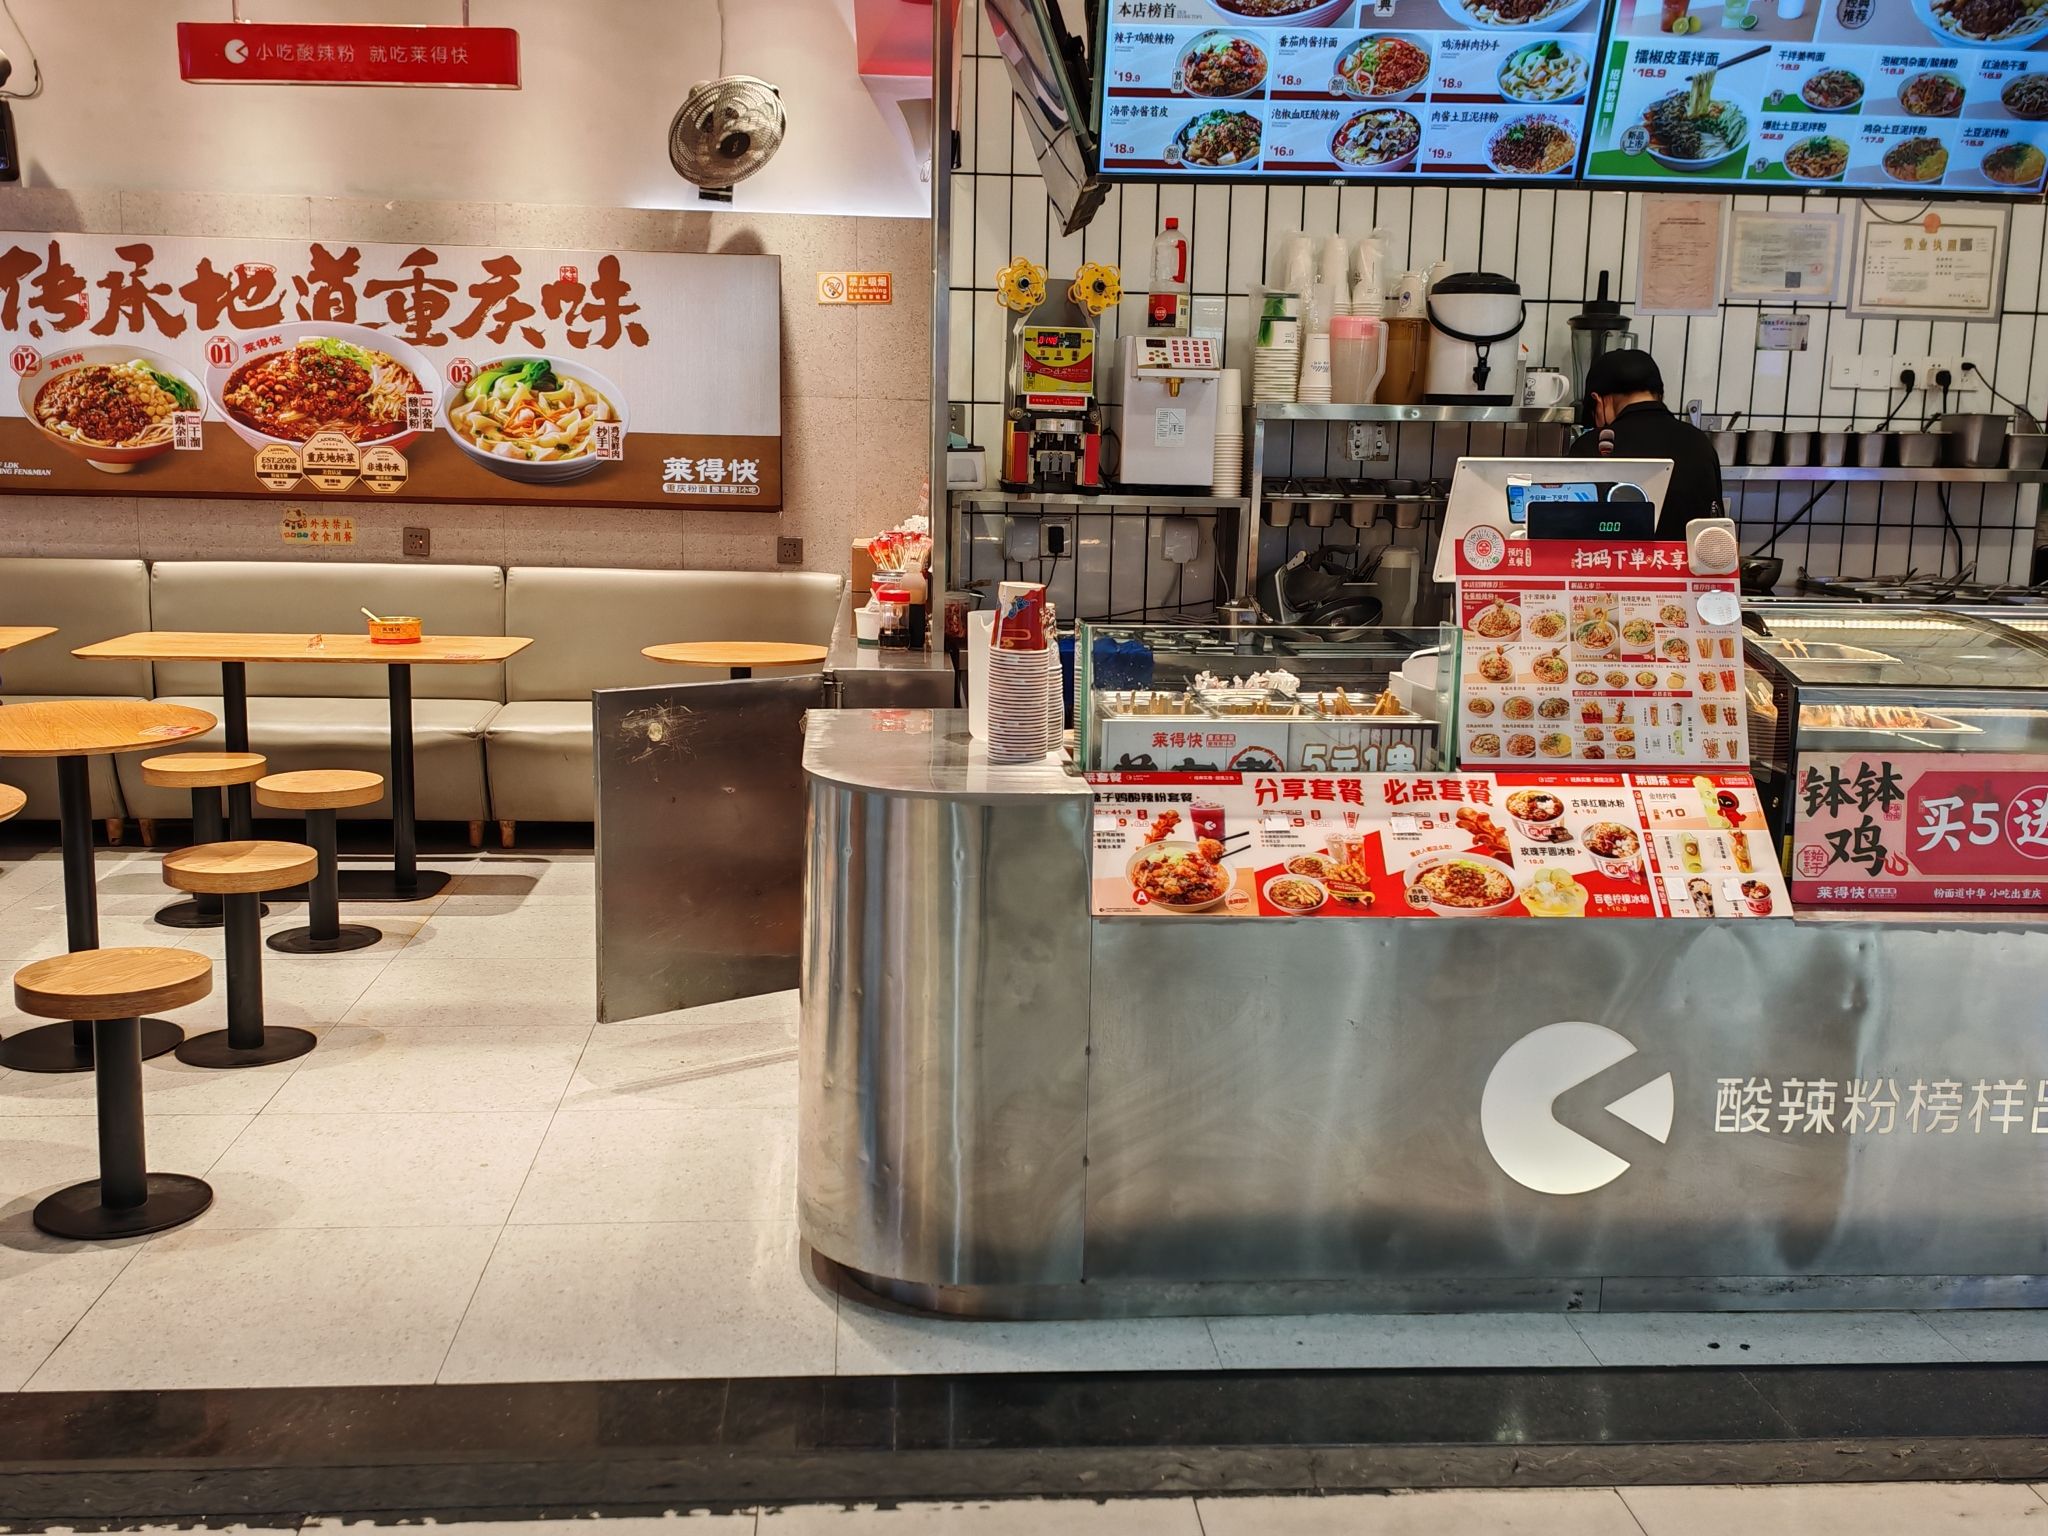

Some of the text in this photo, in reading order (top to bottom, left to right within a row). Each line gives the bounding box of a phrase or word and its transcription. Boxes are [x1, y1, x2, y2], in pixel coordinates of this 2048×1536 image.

[1118, 3, 1177, 19] 本店榜首
[1114, 32, 1175, 45] 辣子鸡酸辣粉
[1278, 35, 1338, 47] 番茄肉酱拌面
[1441, 39, 1500, 51] 鸡汤鲜肉抄手
[256, 43, 469, 65] 小吃酸辣粉 就吃莱得快
[1634, 49, 1720, 66] 擂椒皮蛋拌面
[1109, 105, 1169, 118] 海带杂酱苕皮
[1271, 108, 1340, 121] 泡椒血旺酸辣粉
[1431, 111, 1499, 123] 肉酱土豆泥拌粉
[1627, 131, 1645, 141] 新品
[1625, 140, 1644, 149] 上市
[1904, 237, 1957, 251] 营业执照
[848, 276, 887, 287] 禁止吸烟
[0, 240, 650, 350] 传承地道重庆味
[242, 334, 283, 354] 莱得快
[210, 344, 233, 364] 01
[13, 353, 38, 372] 02
[450, 365, 473, 384] 03
[408, 397, 419, 429] 酸辣粉
[422, 408, 433, 429] 杂酱
[596, 425, 608, 448] 抄手
[610, 425, 621, 459] 鸡汤鲜肉
[306, 453, 356, 464] 重庆地标菜
[367, 462, 401, 472] 非遗传承
[662, 457, 760, 483] 莱得快
[666, 484, 708, 493] 重庆粉面
[310, 519, 353, 530] 外卖禁止
[310, 531, 353, 542] 堂食用餐
[1507, 548, 1523, 558] 预约
[1507, 557, 1524, 567] 点餐
[1152, 732, 1203, 749] 莱得快
[1254, 778, 1365, 807] 分享套餐
[1384, 778, 1494, 807] 必点套餐
[1804, 761, 1905, 818] 钵钵
[1571, 799, 1625, 808] 古早红糖冰粉
[1520, 847, 1576, 856] 玫瑰芋圆冰粉
[1824, 814, 1888, 877] 鸡
[1136, 890, 1148, 902] A
[1408, 895, 1430, 903] 18年
[1817, 886, 1866, 899] 莱得快
[1933, 888, 2042, 899] 粉面道中华 小吃出重庆
